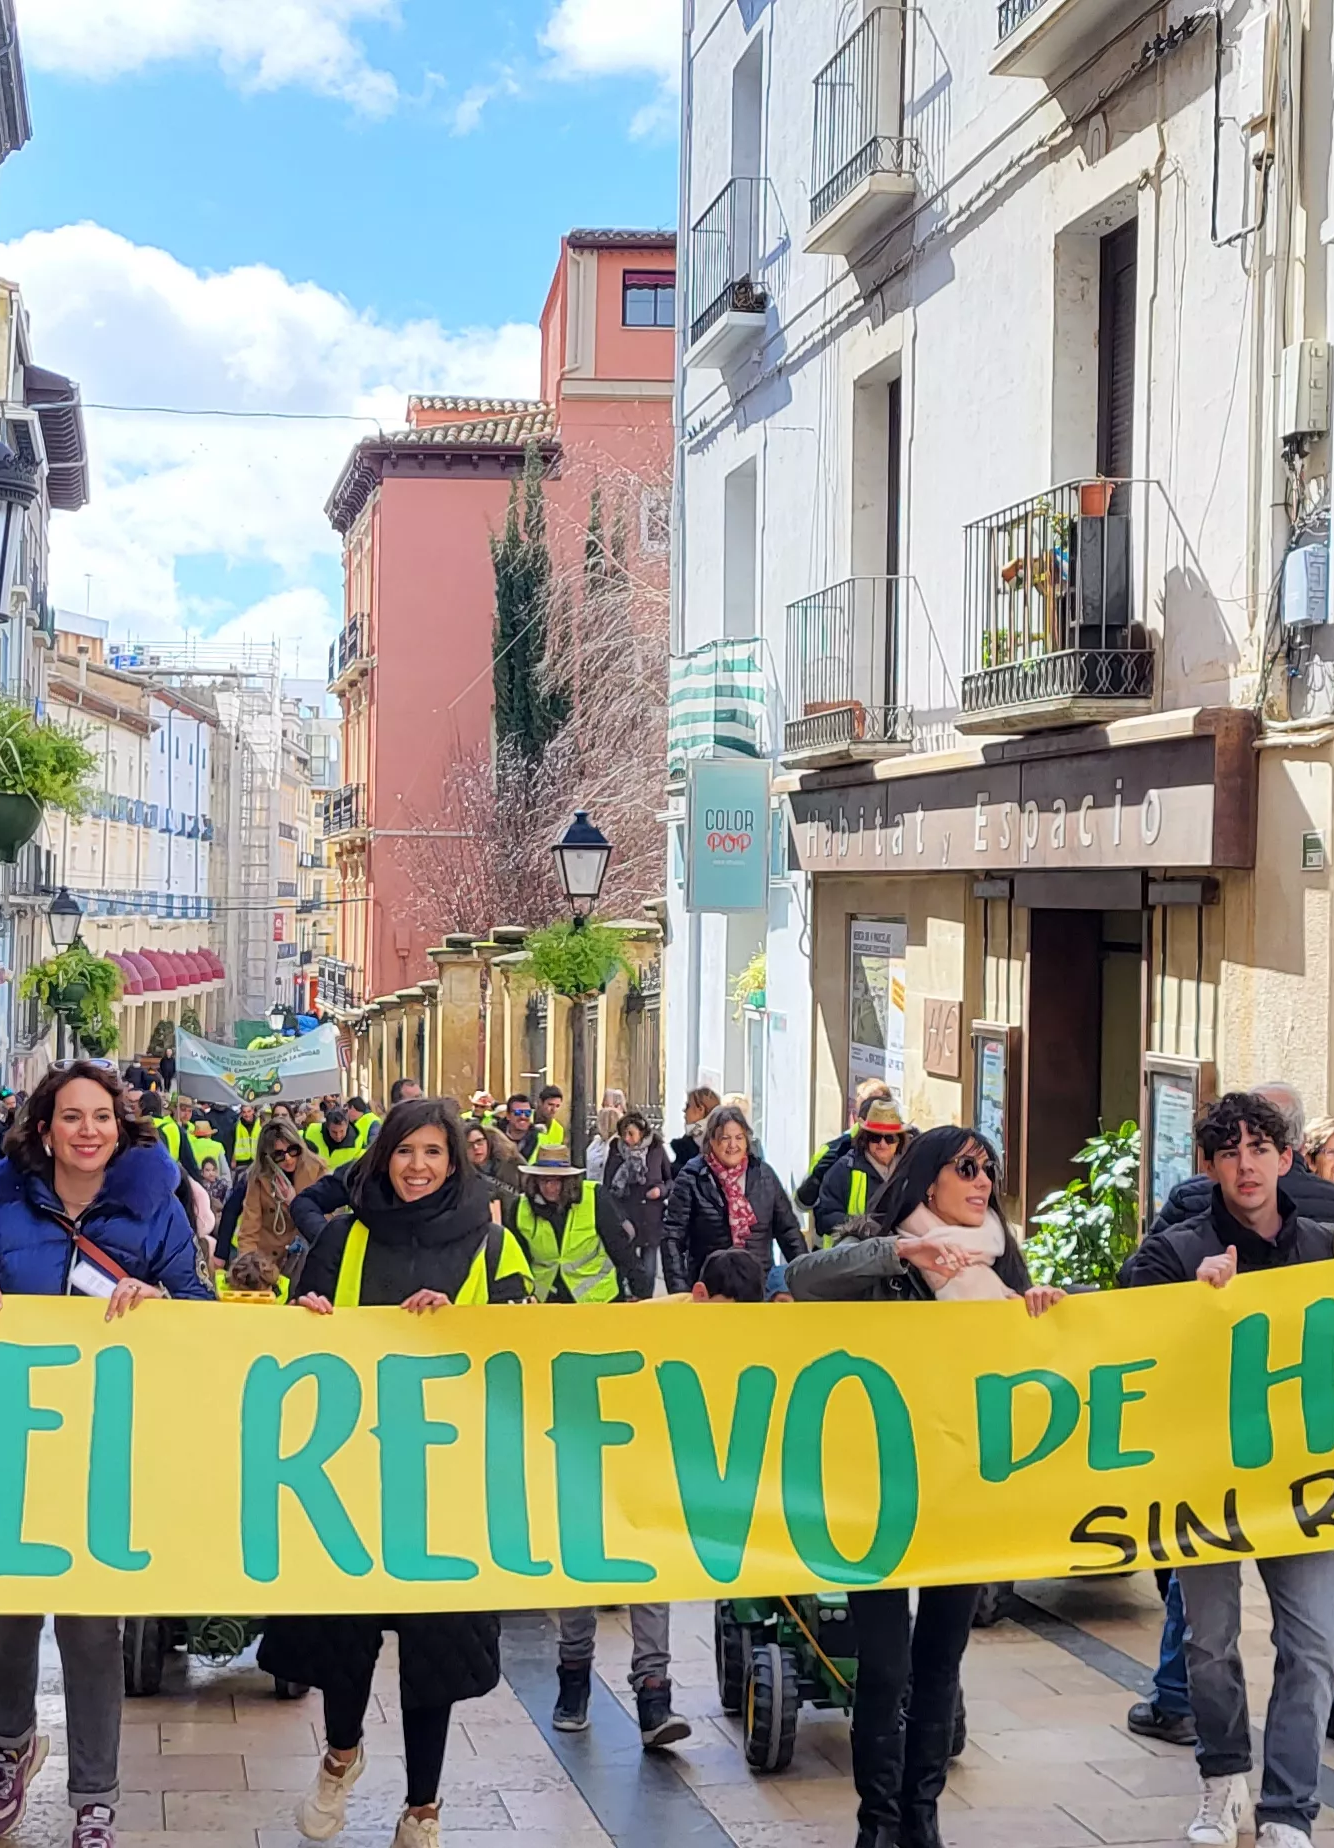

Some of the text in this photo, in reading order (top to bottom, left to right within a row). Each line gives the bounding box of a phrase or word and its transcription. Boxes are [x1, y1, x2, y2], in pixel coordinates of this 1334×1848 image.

[705, 809, 754, 831] COLOR
[707, 832, 752, 854] POP
[806, 779, 1162, 865] Habitat y Espacio
[240, 1349, 920, 1583] RELEVO
[975, 1358, 1158, 1483] DE
[1068, 1488, 1251, 1572] SIN
